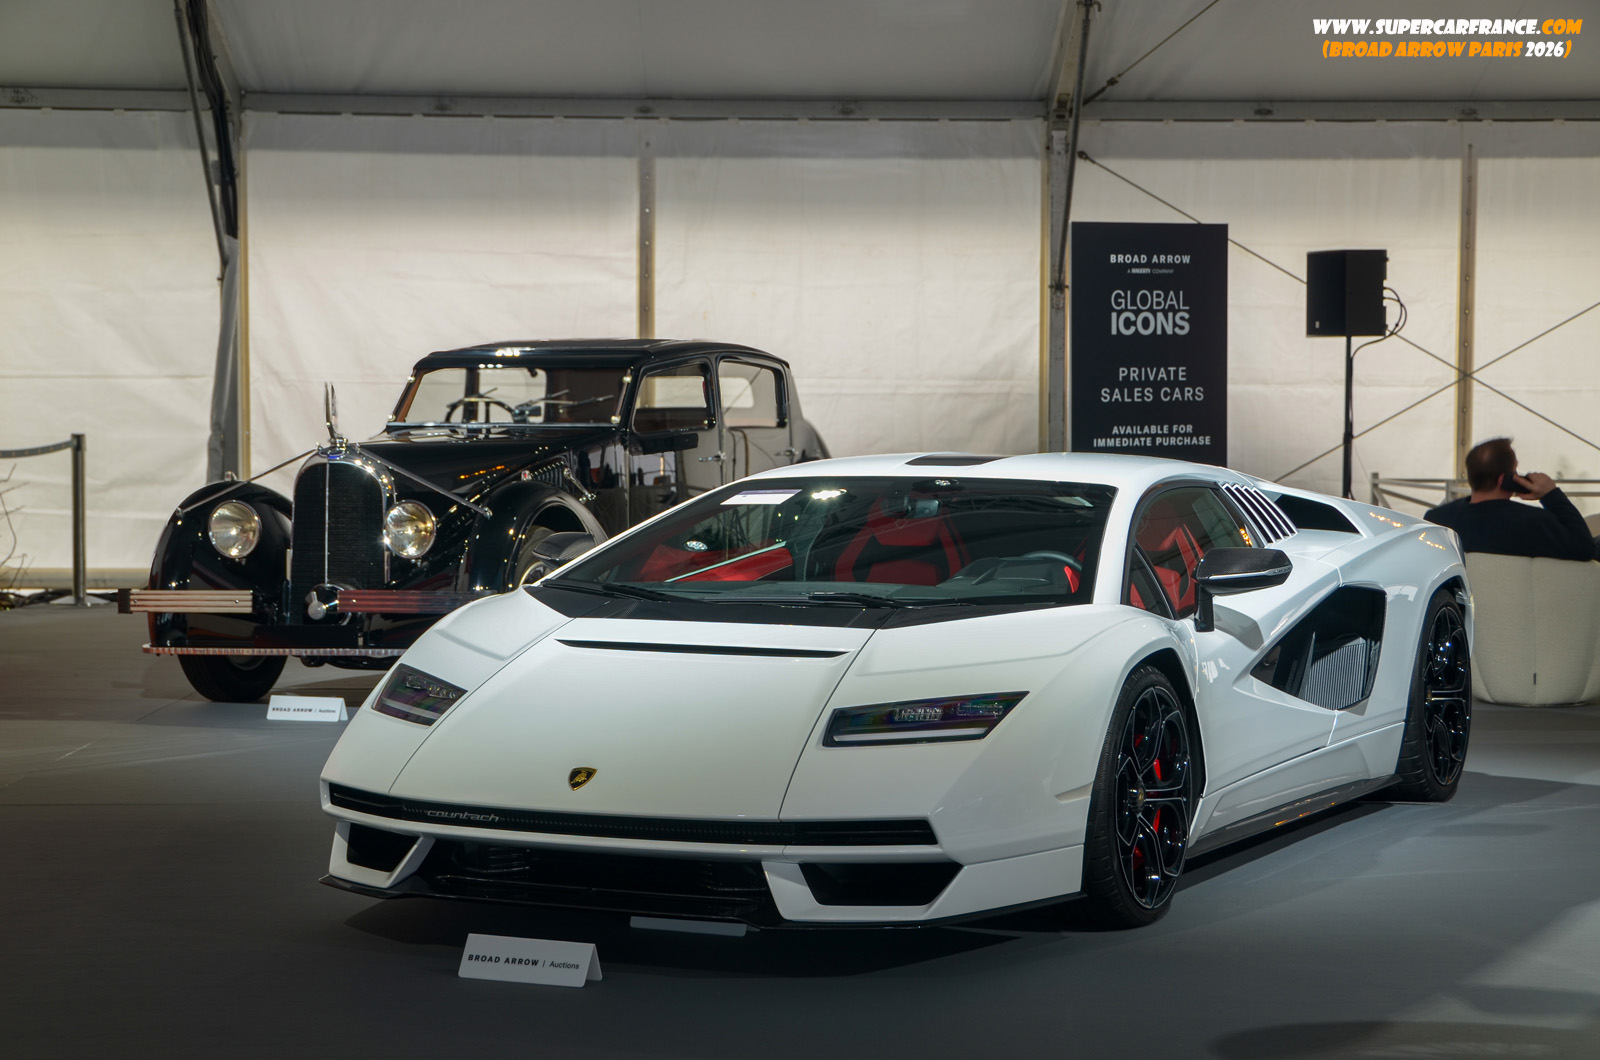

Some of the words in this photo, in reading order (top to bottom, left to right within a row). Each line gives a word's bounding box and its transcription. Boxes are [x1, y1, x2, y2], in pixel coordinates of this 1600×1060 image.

[1110, 254, 1148, 264] BROAD
[1152, 254, 1191, 264] ARROW
[1111, 289, 1190, 310] GLOBAL
[1111, 311, 1190, 336] ICONS
[1119, 367, 1187, 381] PRIVATE
[1100, 387, 1153, 403] SALES
[1160, 386, 1205, 402] CARS
[1112, 424, 1169, 435] AVAILABLE
[1173, 424, 1193, 434] FOR
[1093, 437, 1152, 447] IMMEDIATE
[1155, 436, 1211, 446] PURCHASE
[427, 809, 500, 823] countach
[467, 954, 501, 963] BROAD
[504, 958, 540, 967] ARROW
[549, 960, 580, 970] Auctions
